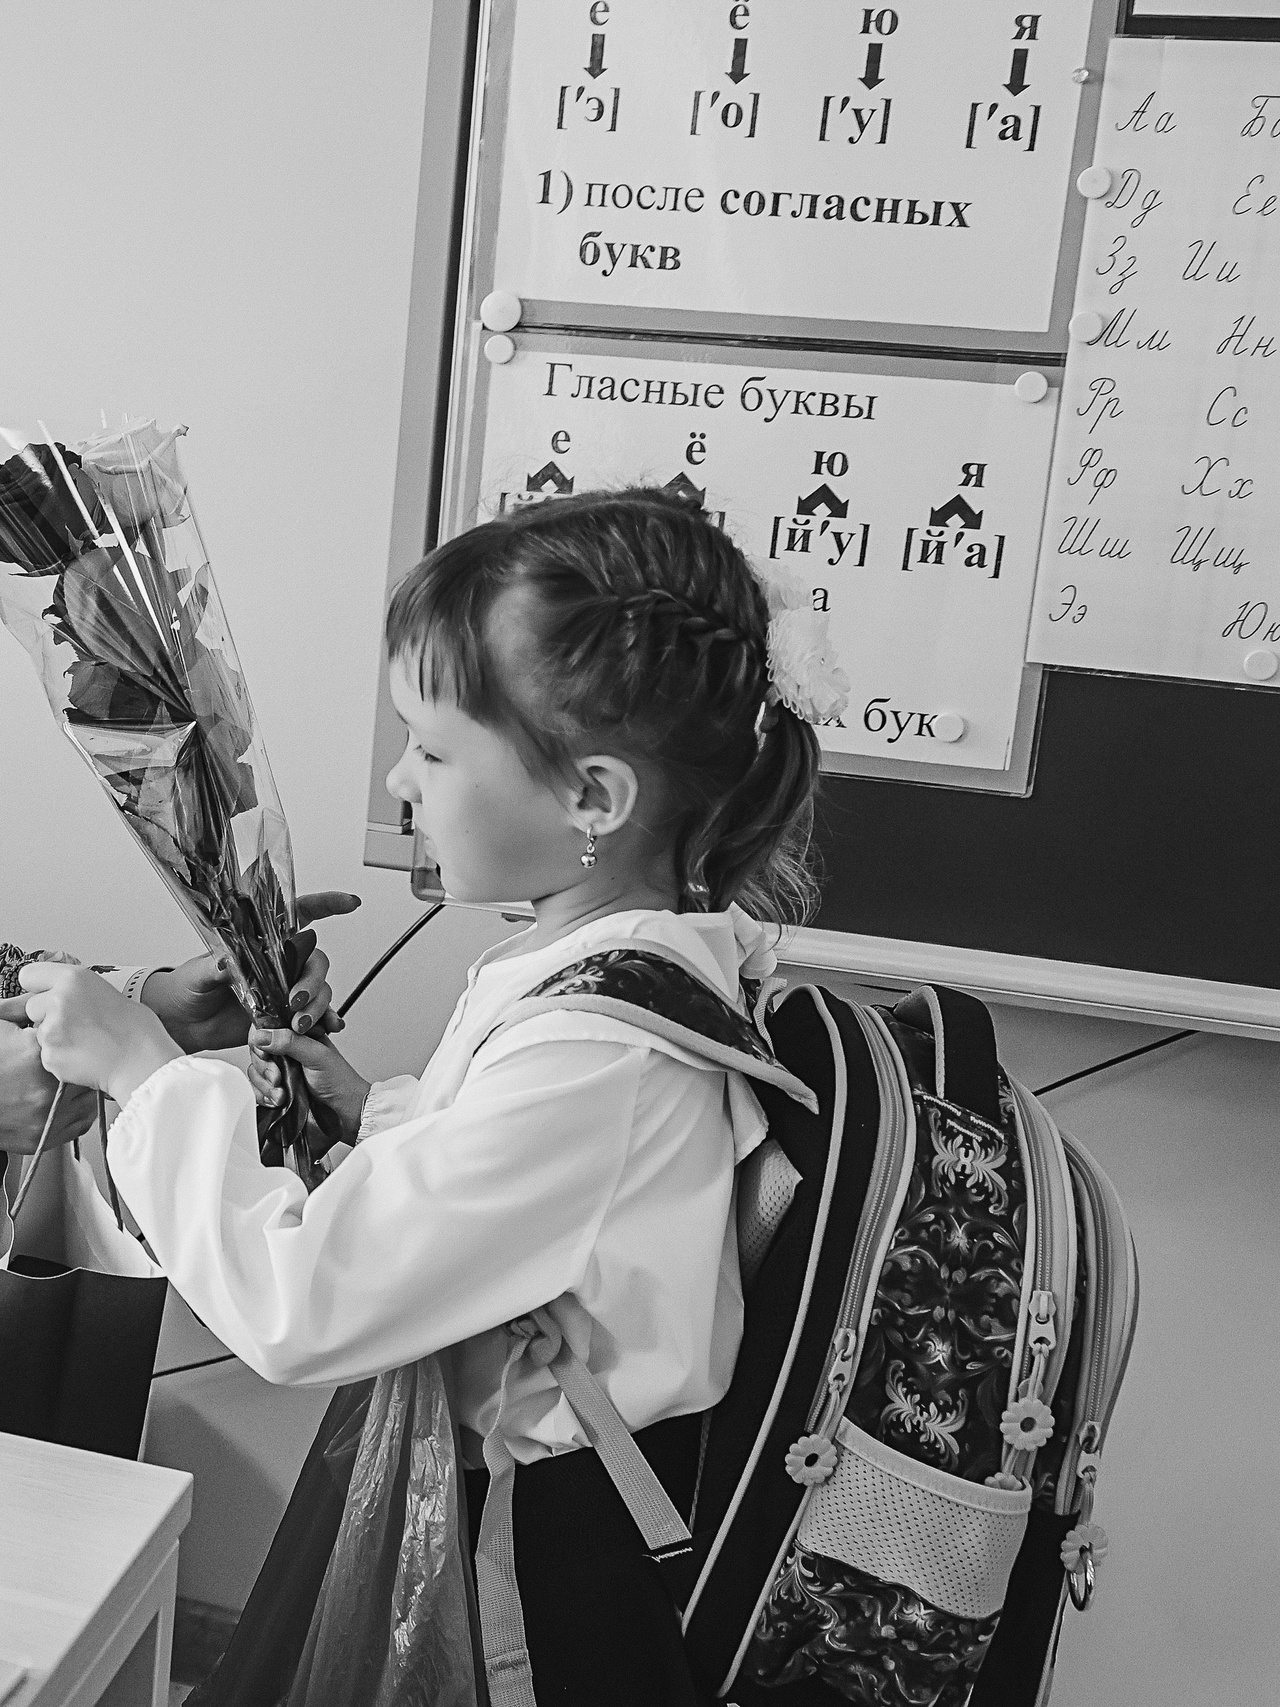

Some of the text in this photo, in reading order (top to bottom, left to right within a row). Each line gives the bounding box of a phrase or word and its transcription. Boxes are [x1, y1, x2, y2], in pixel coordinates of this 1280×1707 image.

[590, 0, 1042, 40] е ё ю я
[537, 170, 972, 228] 1) после согласных
[579, 231, 681, 277] букв
[543, 362, 878, 423] Гласные буквы
[551, 430, 988, 488] е ё ю я
[864, 698, 940, 743] бук
